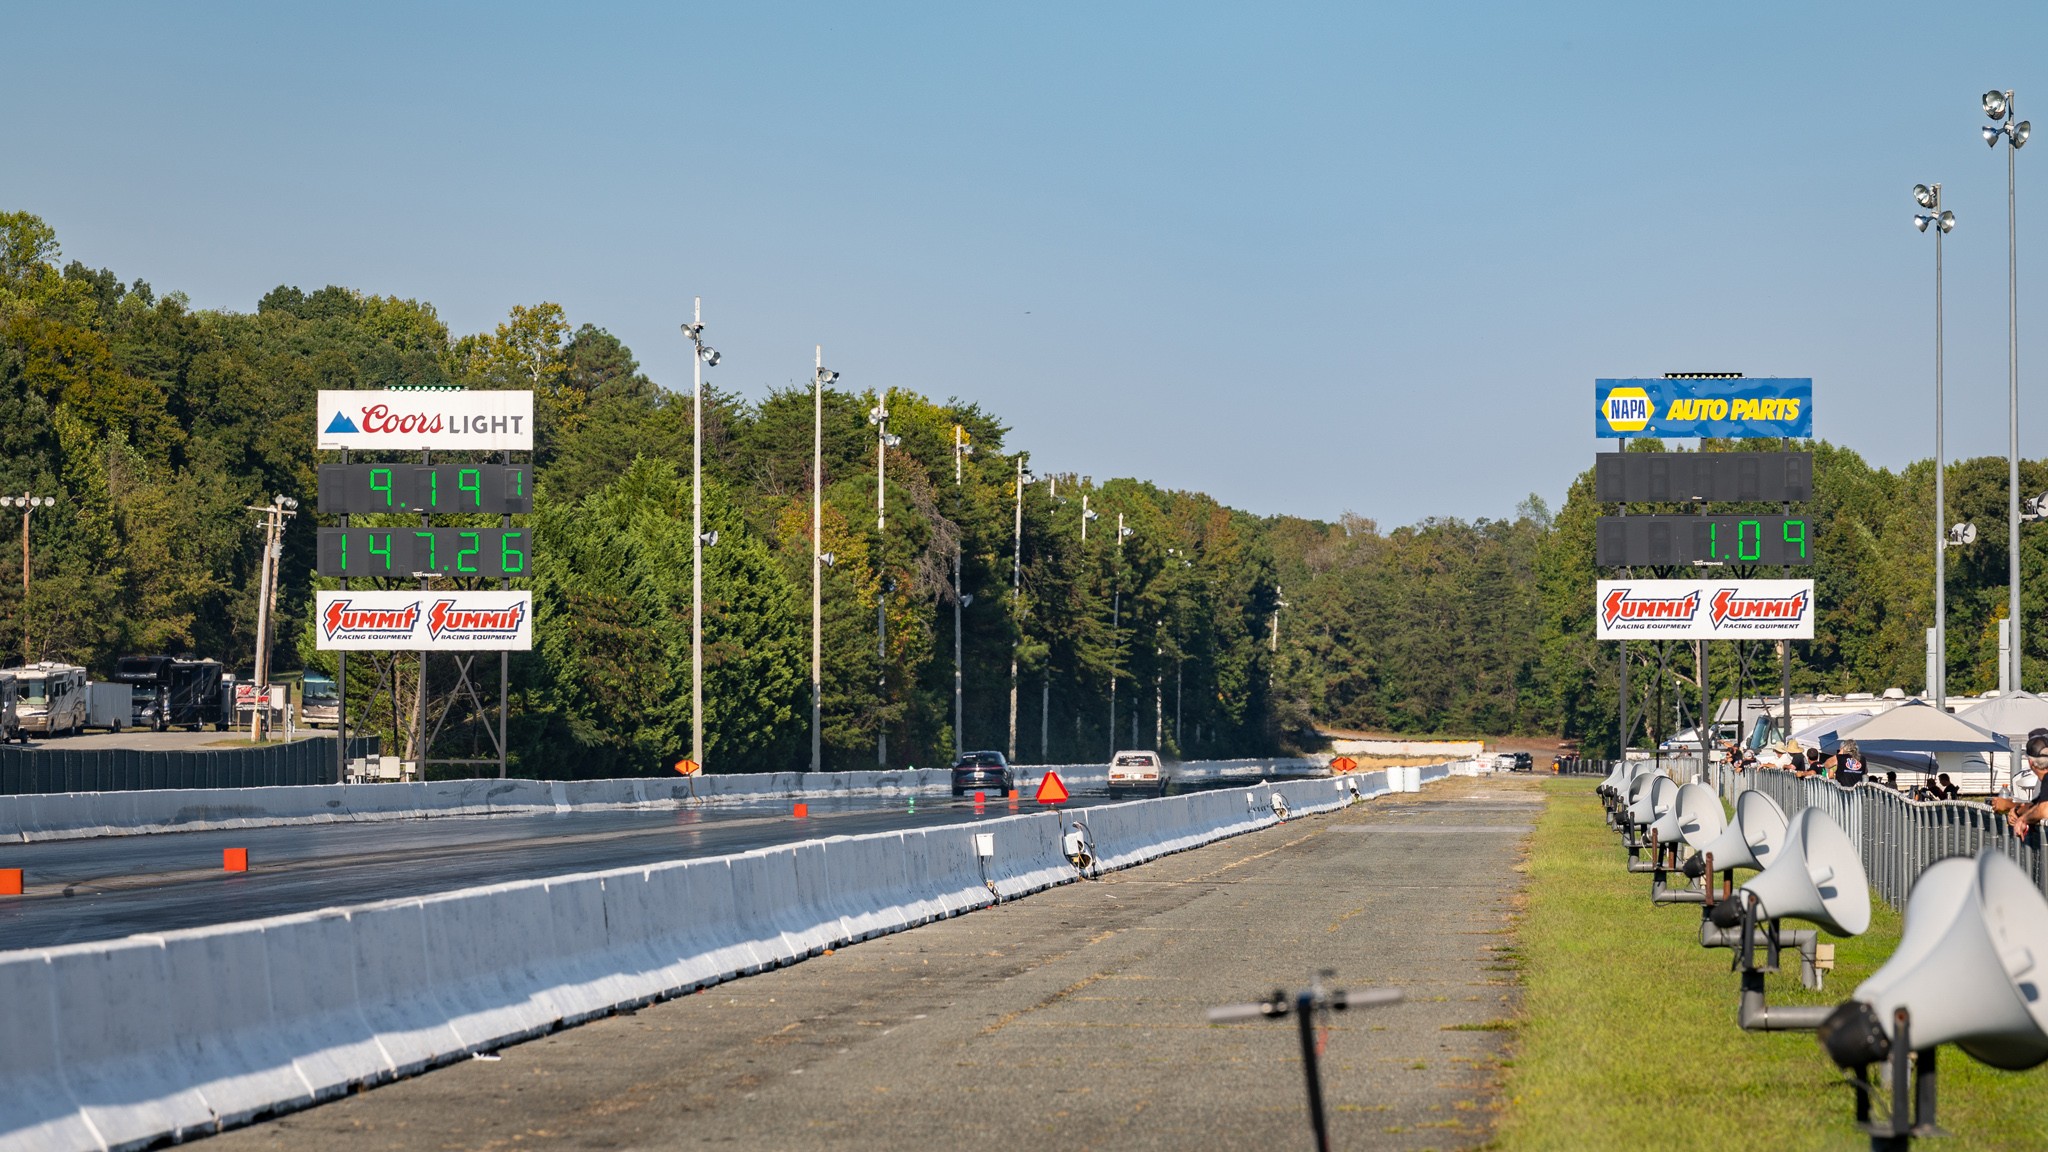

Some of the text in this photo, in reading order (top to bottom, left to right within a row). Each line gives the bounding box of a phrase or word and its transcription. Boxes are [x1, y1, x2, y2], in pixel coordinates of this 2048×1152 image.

[362, 404, 523, 434] Coors LIGHT
[1611, 399, 1646, 419] NAPA
[1666, 398, 1801, 420] AUTO PARTS
[341, 532, 524, 572] 147.26
[1711, 520, 1805, 560] 1.09
